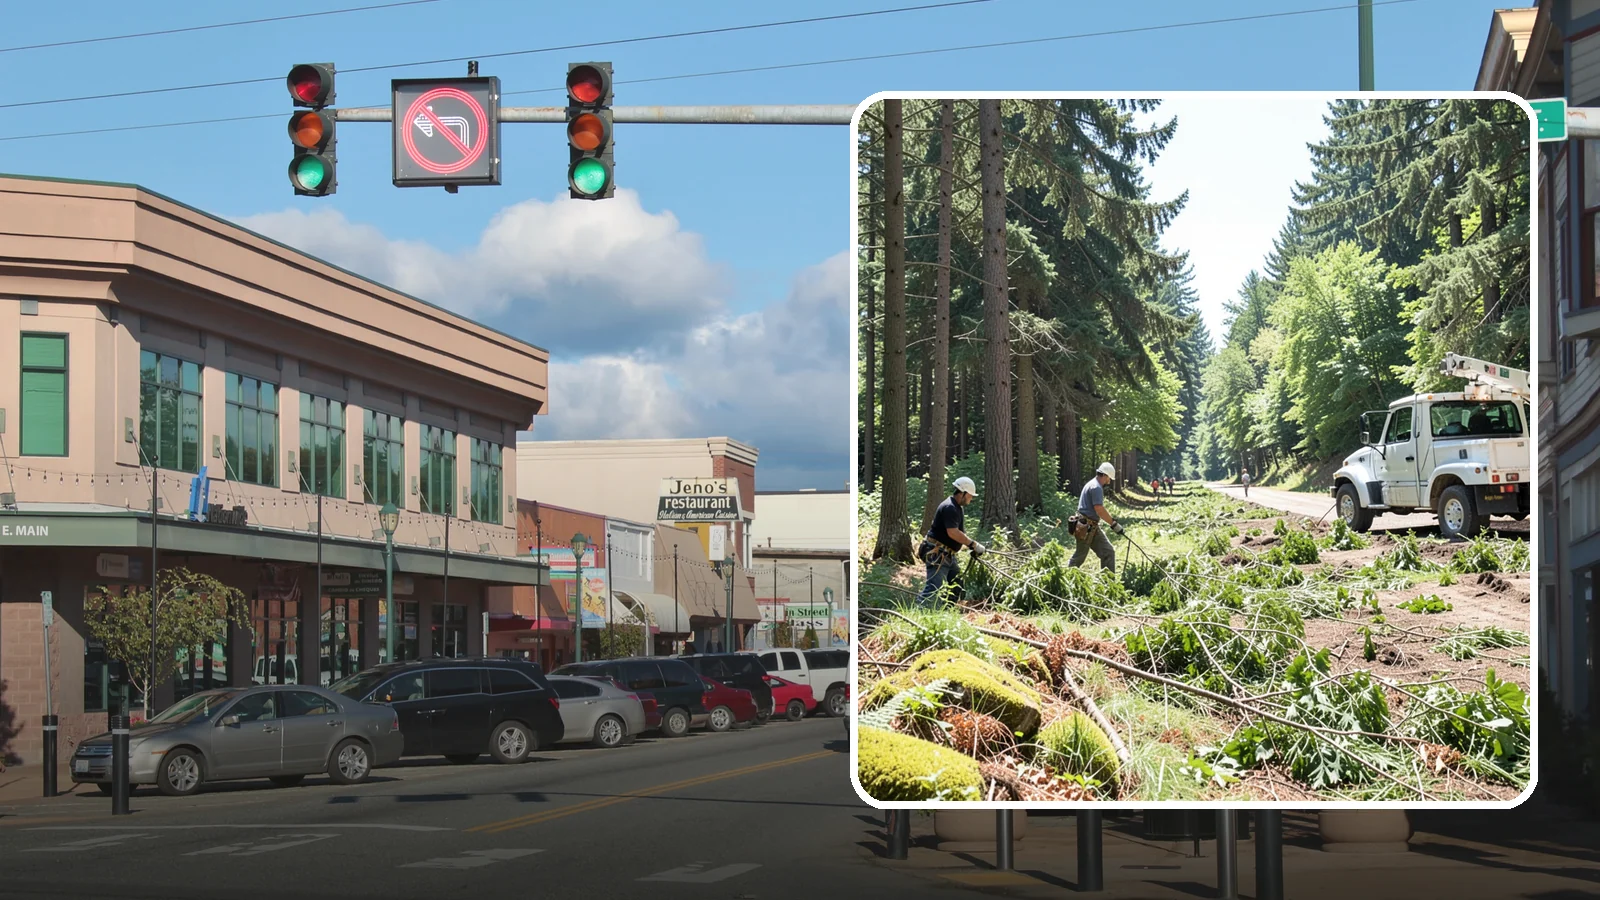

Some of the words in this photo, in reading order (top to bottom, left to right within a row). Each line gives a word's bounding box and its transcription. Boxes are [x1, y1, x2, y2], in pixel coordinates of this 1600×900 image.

[670, 480, 727, 494] Jeno's
[665, 496, 731, 509] restaurant
[659, 510, 681, 519] Italian
[686, 510, 714, 519] American
[715, 509, 737, 519] Cuisine
[2, 525, 13, 536] E.
[16, 525, 49, 536] MAIN
[797, 608, 828, 616] Street
